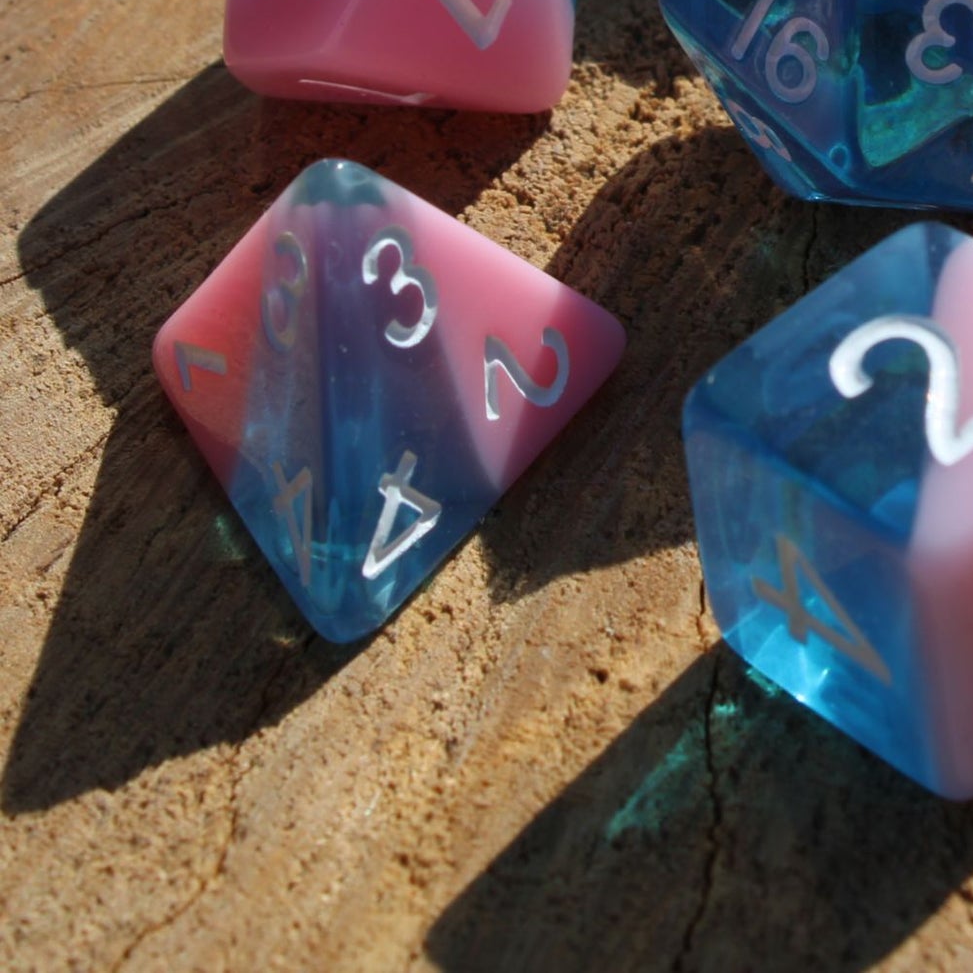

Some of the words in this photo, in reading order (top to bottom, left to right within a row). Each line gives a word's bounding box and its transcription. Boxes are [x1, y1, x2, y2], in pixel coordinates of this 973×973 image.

[362, 224, 438, 348] 3
[484, 326, 570, 421] 2
[362, 450, 442, 580] 4
[751, 532, 892, 687] 4
